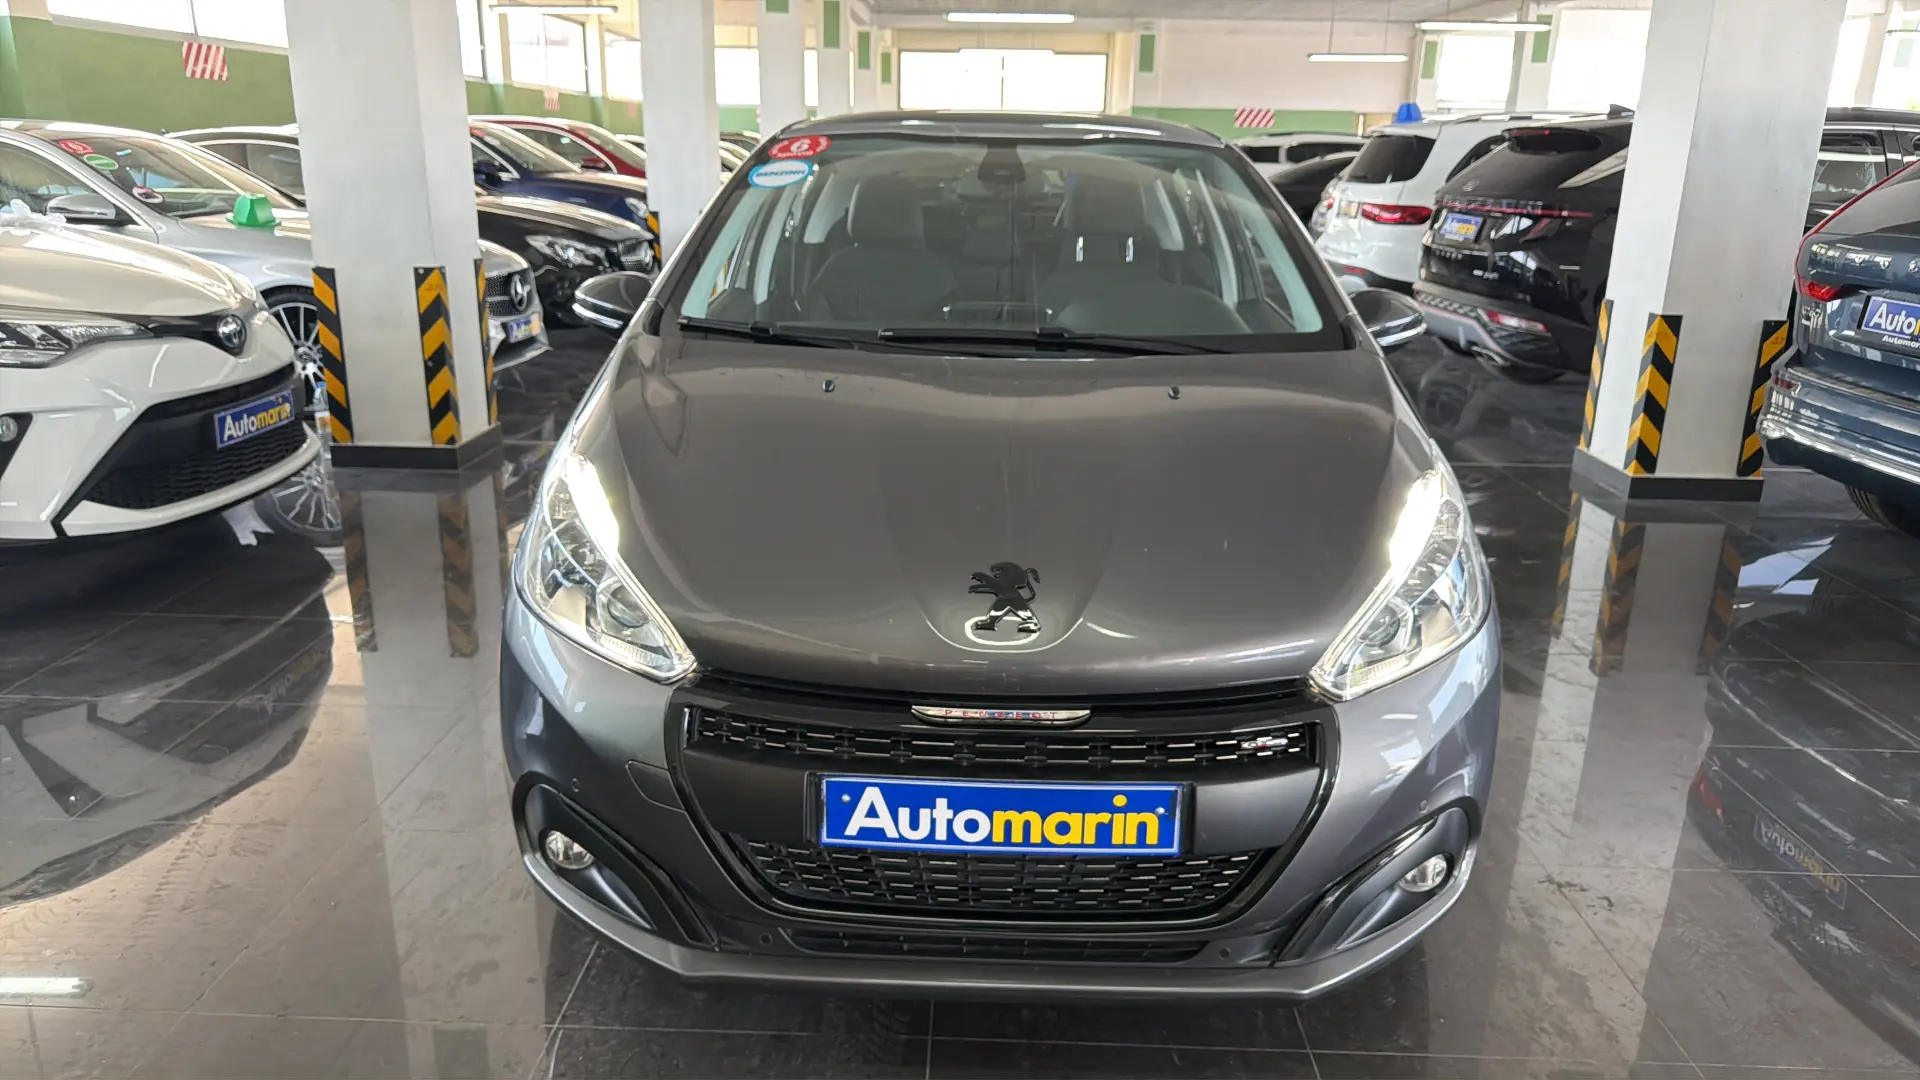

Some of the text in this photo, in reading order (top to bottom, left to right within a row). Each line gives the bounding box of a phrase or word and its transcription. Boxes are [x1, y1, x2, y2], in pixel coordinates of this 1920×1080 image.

[790, 138, 811, 153] 6
[223, 396, 291, 442] Automarin
[944, 709, 1058, 720] PEUGEOT
[844, 786, 1159, 845] Automarin
